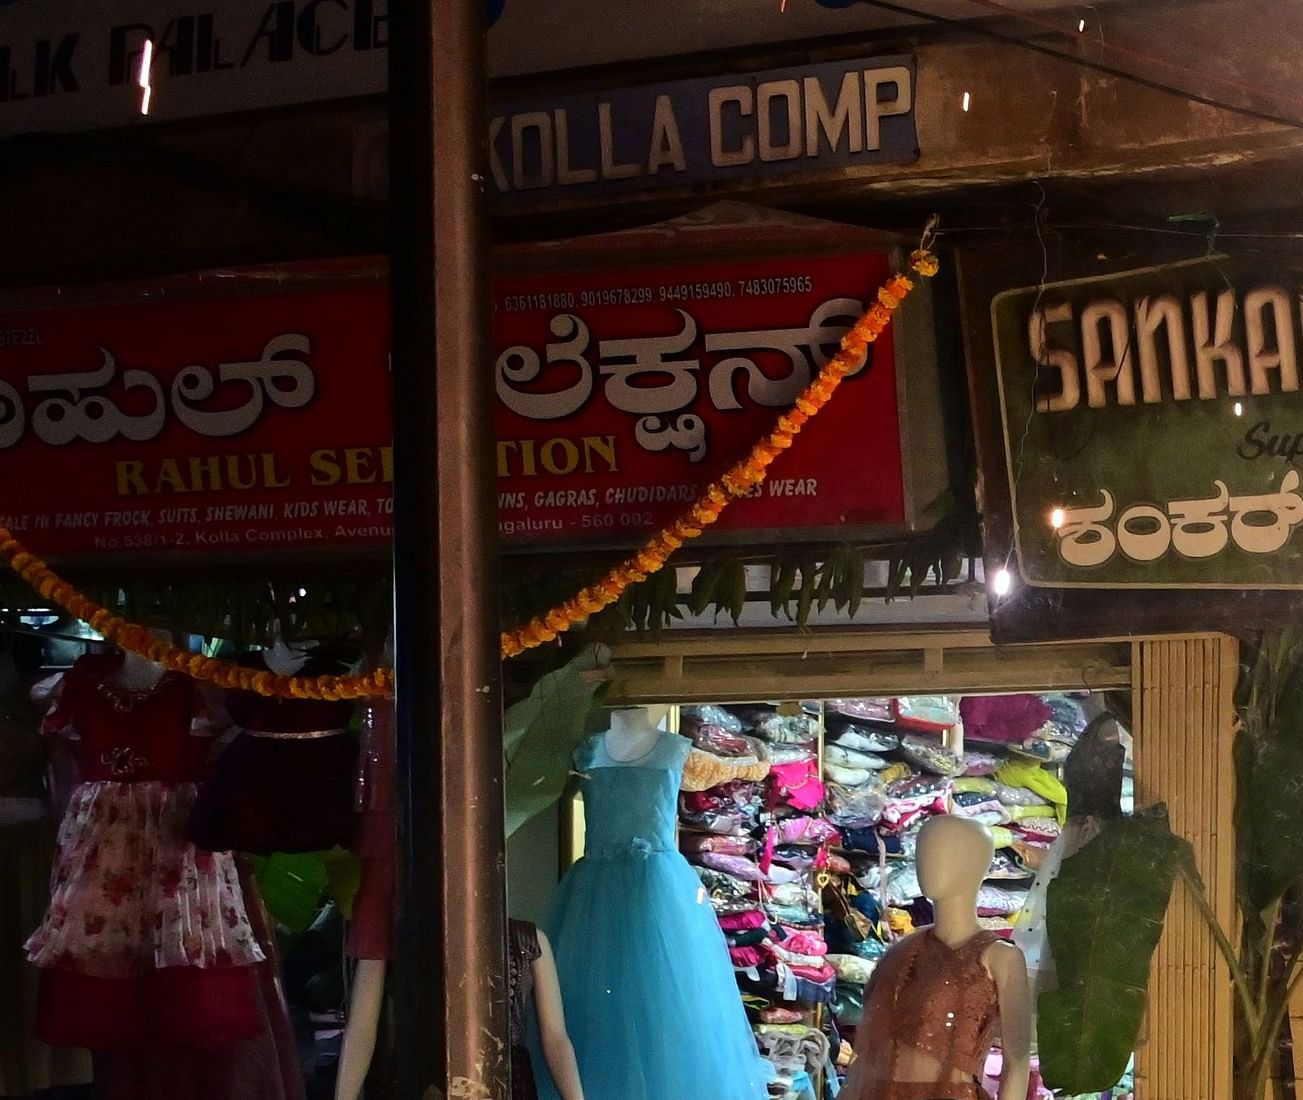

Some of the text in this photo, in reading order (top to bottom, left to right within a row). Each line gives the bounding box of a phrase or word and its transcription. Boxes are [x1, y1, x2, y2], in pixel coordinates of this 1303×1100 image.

[707, 64, 912, 168] COMP
[114, 451, 291, 496] RAHUL
[768, 478, 818, 498] WEAR
[334, 524, 393, 539] Avenu
